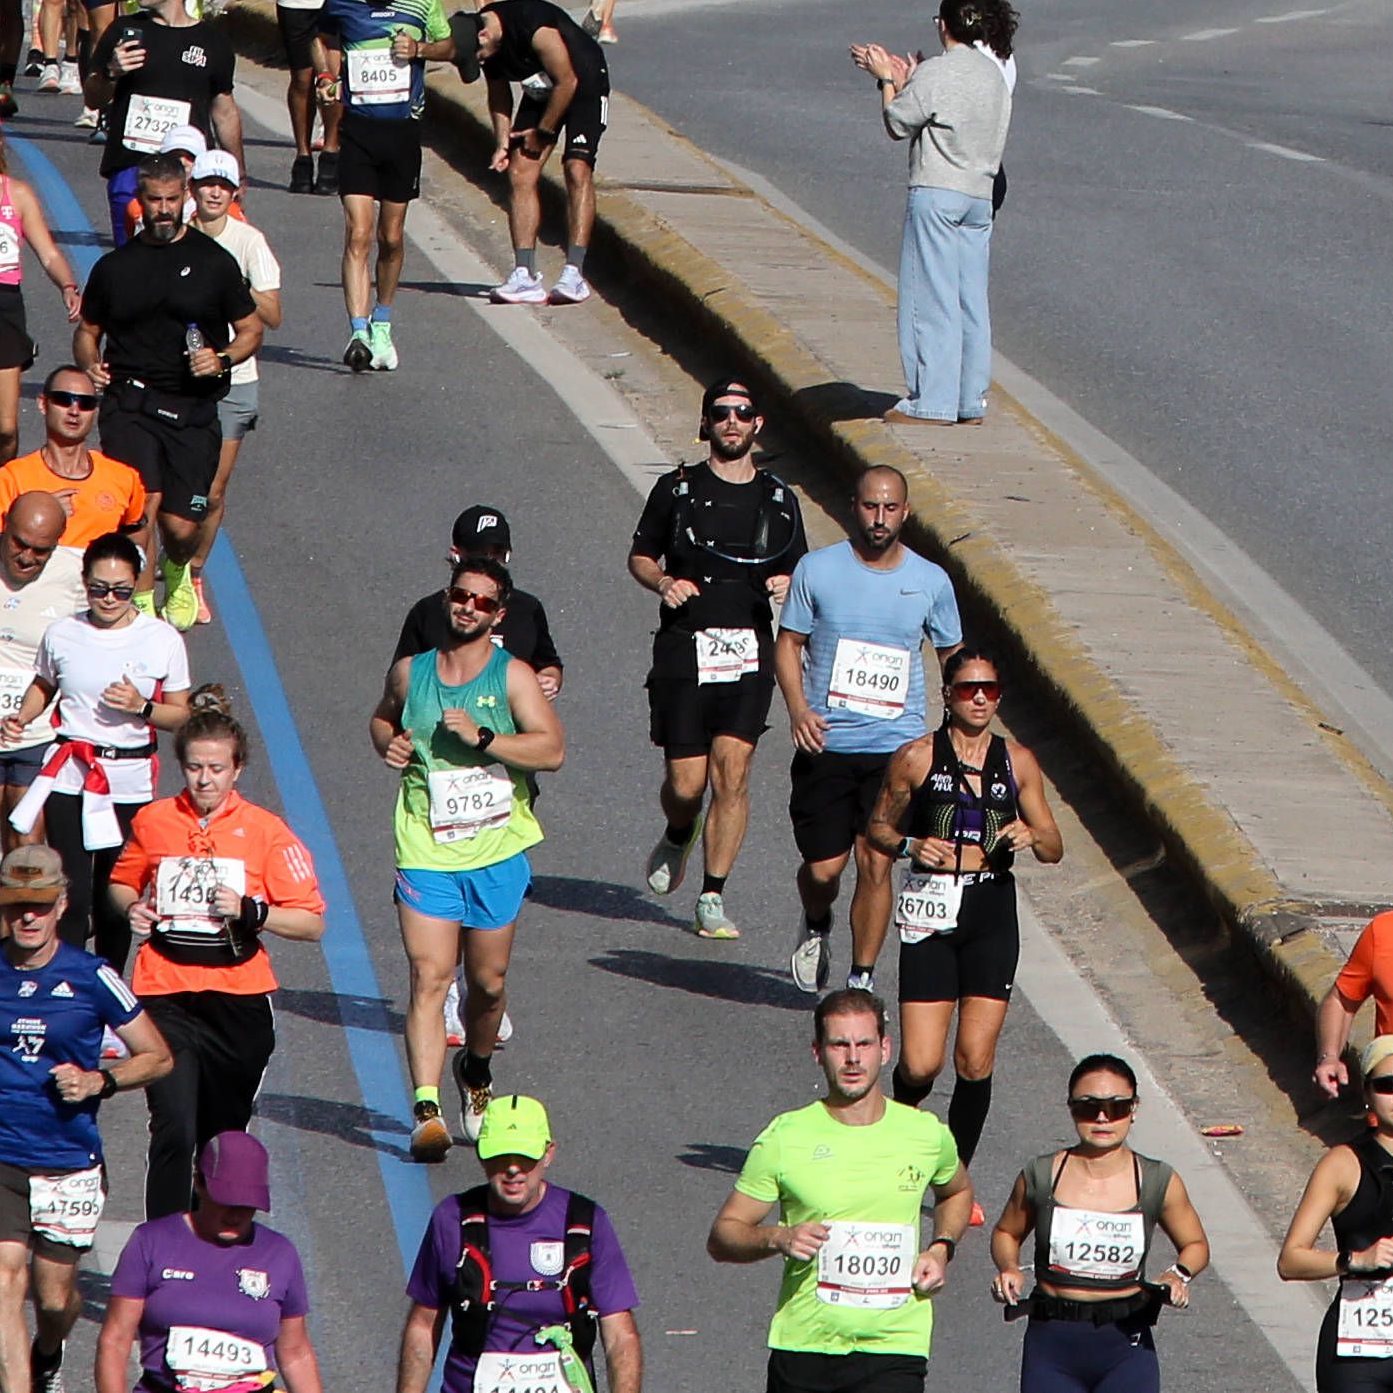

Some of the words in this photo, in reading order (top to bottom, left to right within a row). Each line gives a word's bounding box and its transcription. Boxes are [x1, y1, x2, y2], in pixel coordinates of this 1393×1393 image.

[360, 70, 397, 84] 8405
[844, 668, 900, 693] 18490
[446, 791, 495, 816] 9782
[898, 896, 947, 920] 26703
[1064, 1241, 1135, 1264] 12582
[833, 1254, 901, 1278] 18030
[183, 1336, 252, 1365] 14493
